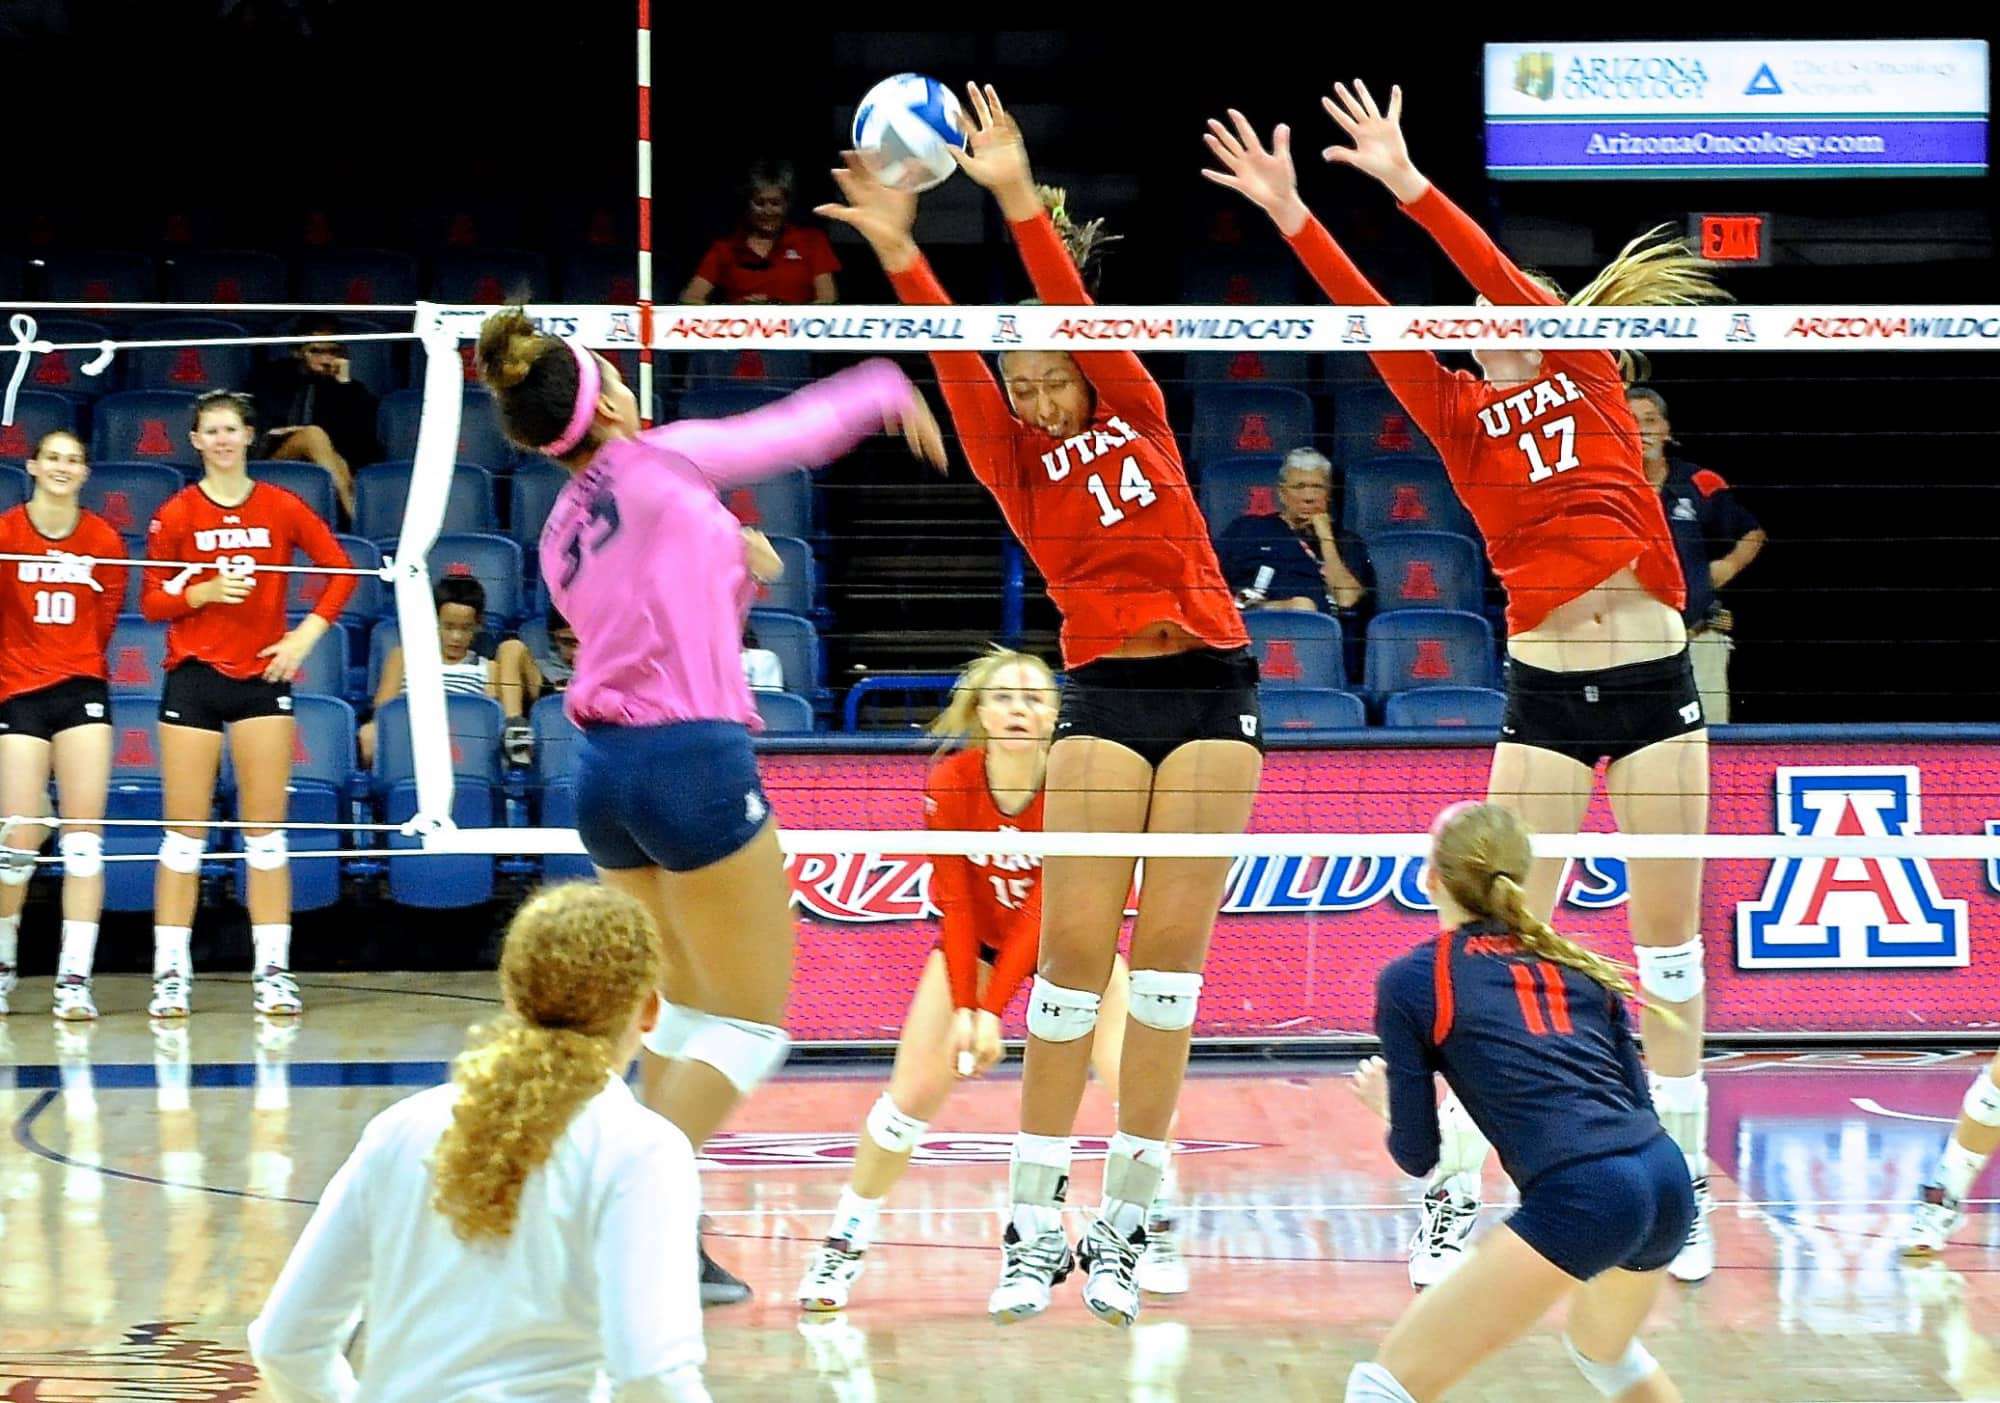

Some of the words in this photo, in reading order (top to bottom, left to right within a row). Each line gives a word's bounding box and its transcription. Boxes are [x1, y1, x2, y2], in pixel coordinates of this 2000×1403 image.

[1561, 79, 1705, 100] ONCOLOGY
[1564, 55, 1710, 83] ARIZONA
[1583, 130, 1886, 160] ArizonaOncology.com
[1518, 415, 1581, 483] 17
[1087, 455, 1158, 528] 14
[32, 589, 77, 625] 10
[1737, 766, 1971, 969] A
[1508, 960, 1576, 1037] 11
